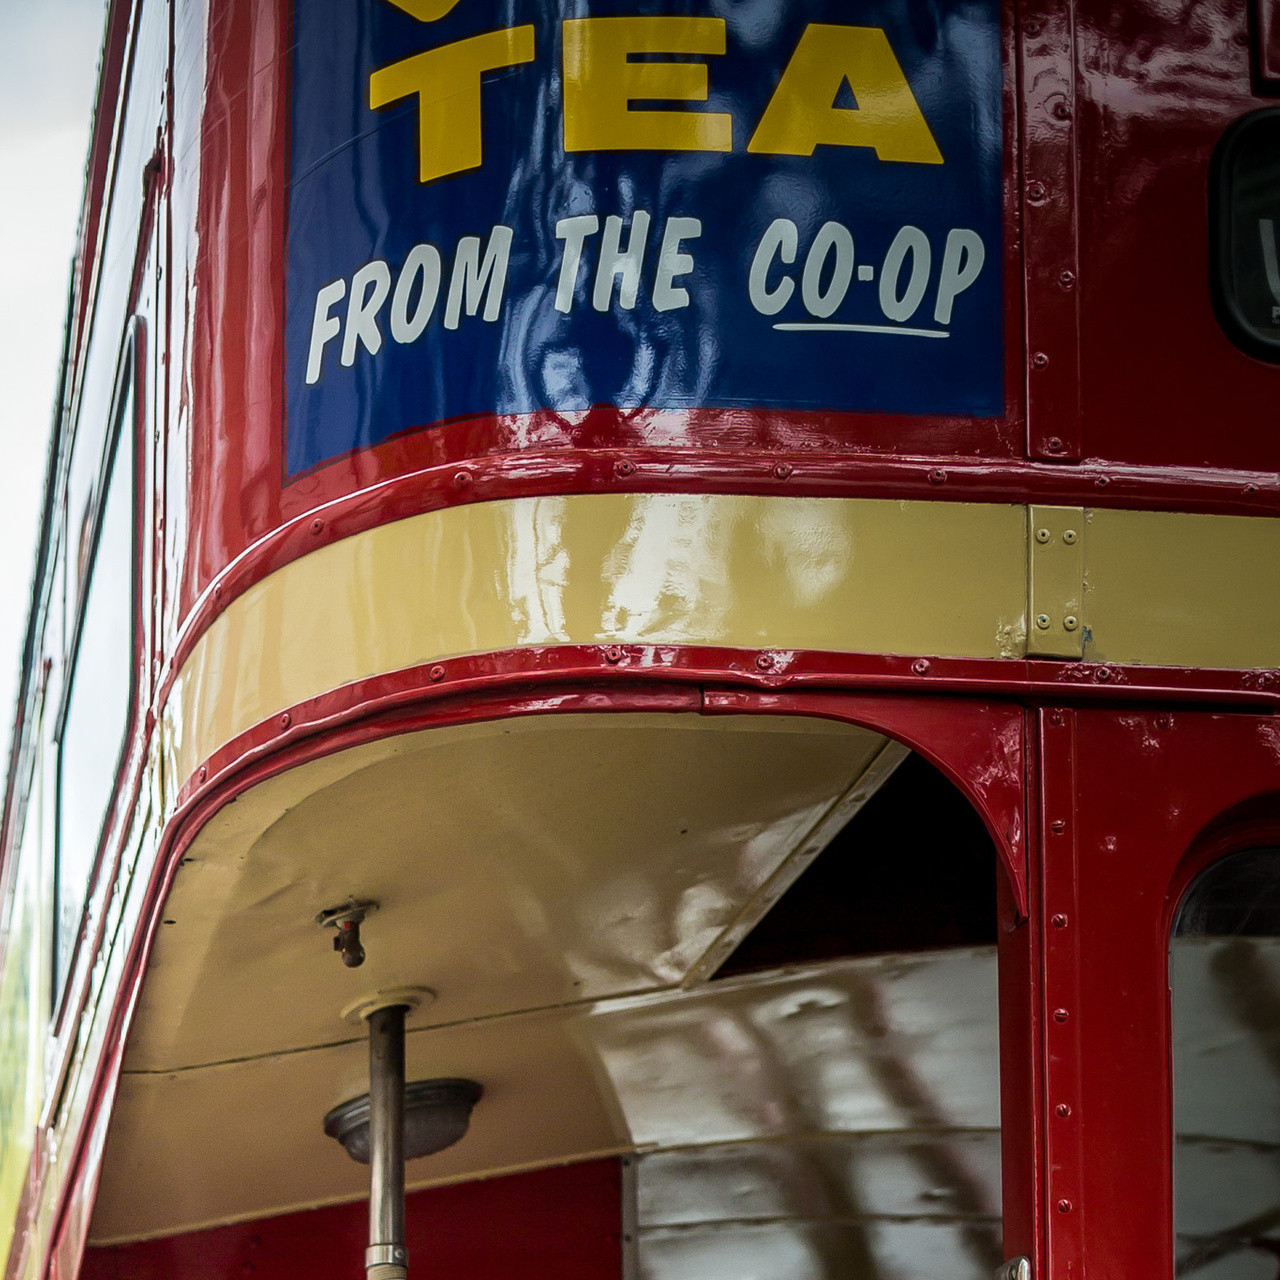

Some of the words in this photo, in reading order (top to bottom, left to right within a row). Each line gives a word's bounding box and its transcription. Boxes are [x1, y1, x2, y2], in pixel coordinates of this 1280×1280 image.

[369, 16, 945, 184] TEA
[305, 224, 514, 385] FROM
[554, 210, 703, 314] THE
[748, 217, 986, 325] CO-OP
